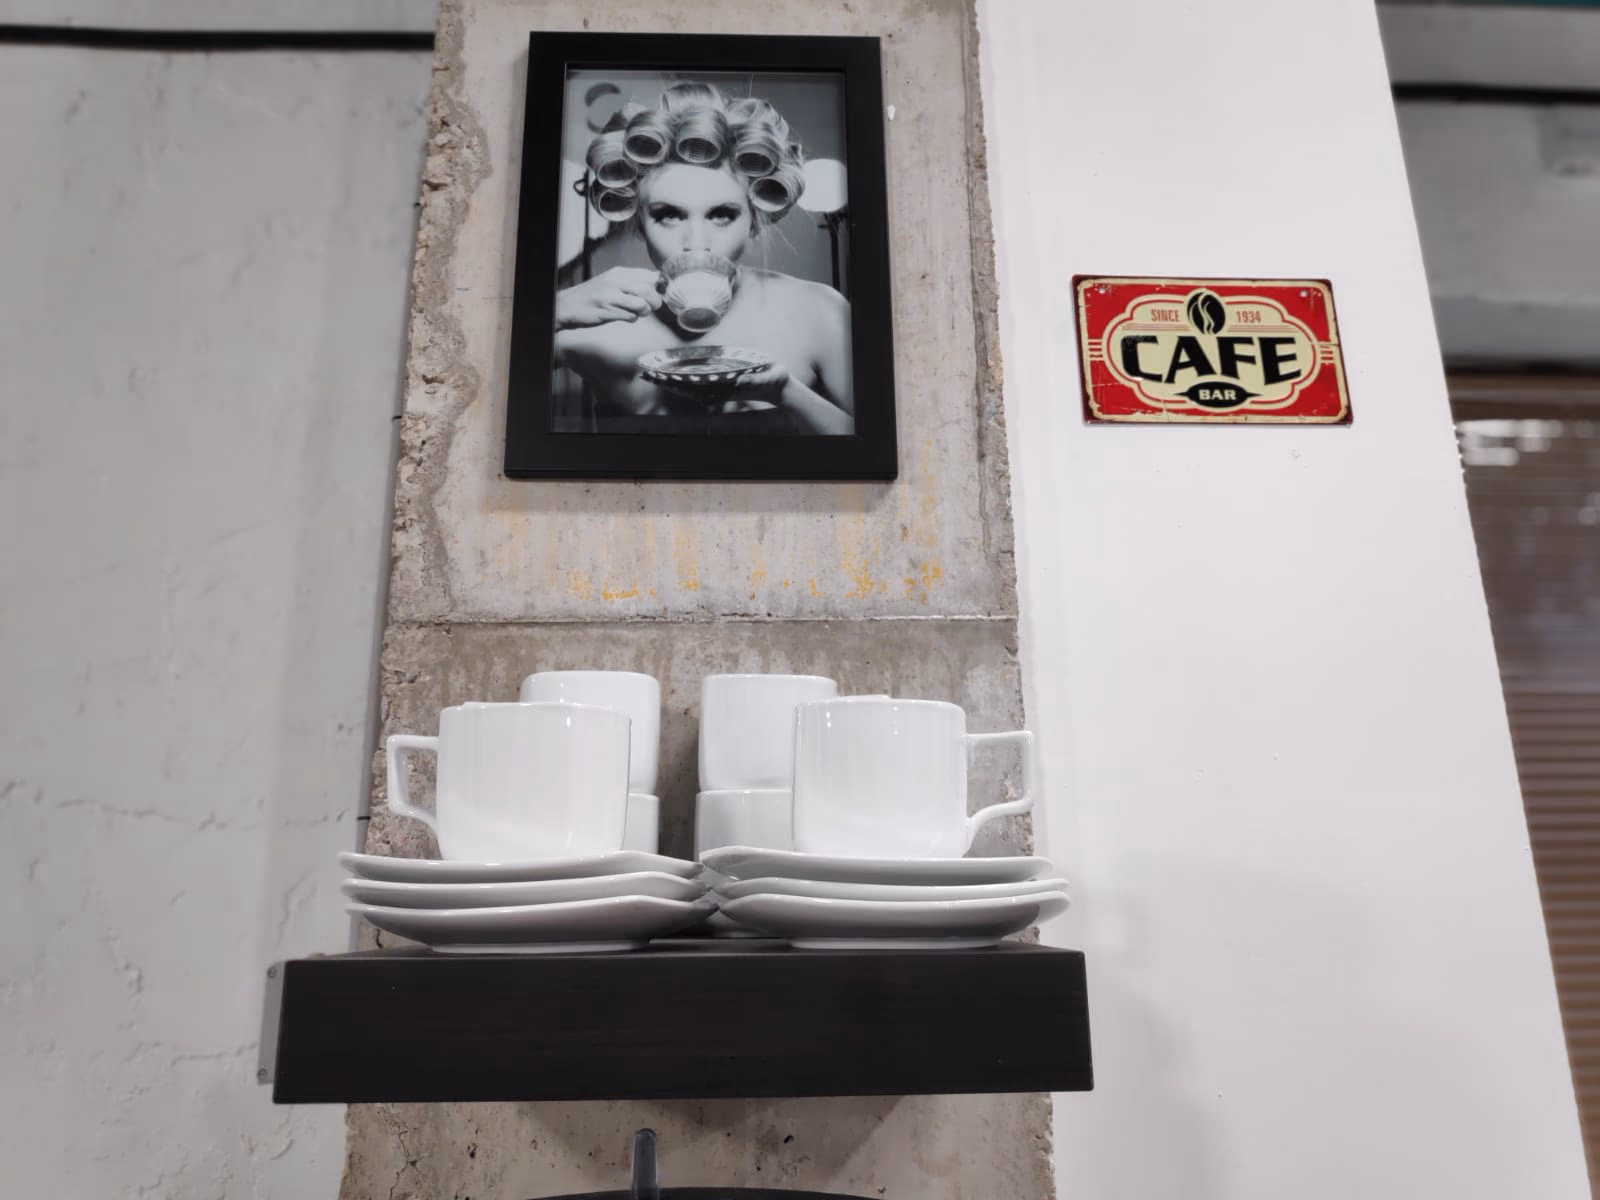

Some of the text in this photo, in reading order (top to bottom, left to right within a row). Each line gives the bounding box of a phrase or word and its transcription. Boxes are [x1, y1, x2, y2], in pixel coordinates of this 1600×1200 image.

[1151, 309, 1261, 323] SINCE 1934
[1120, 335, 1302, 386] CAFE
[1198, 389, 1237, 401] BAR
